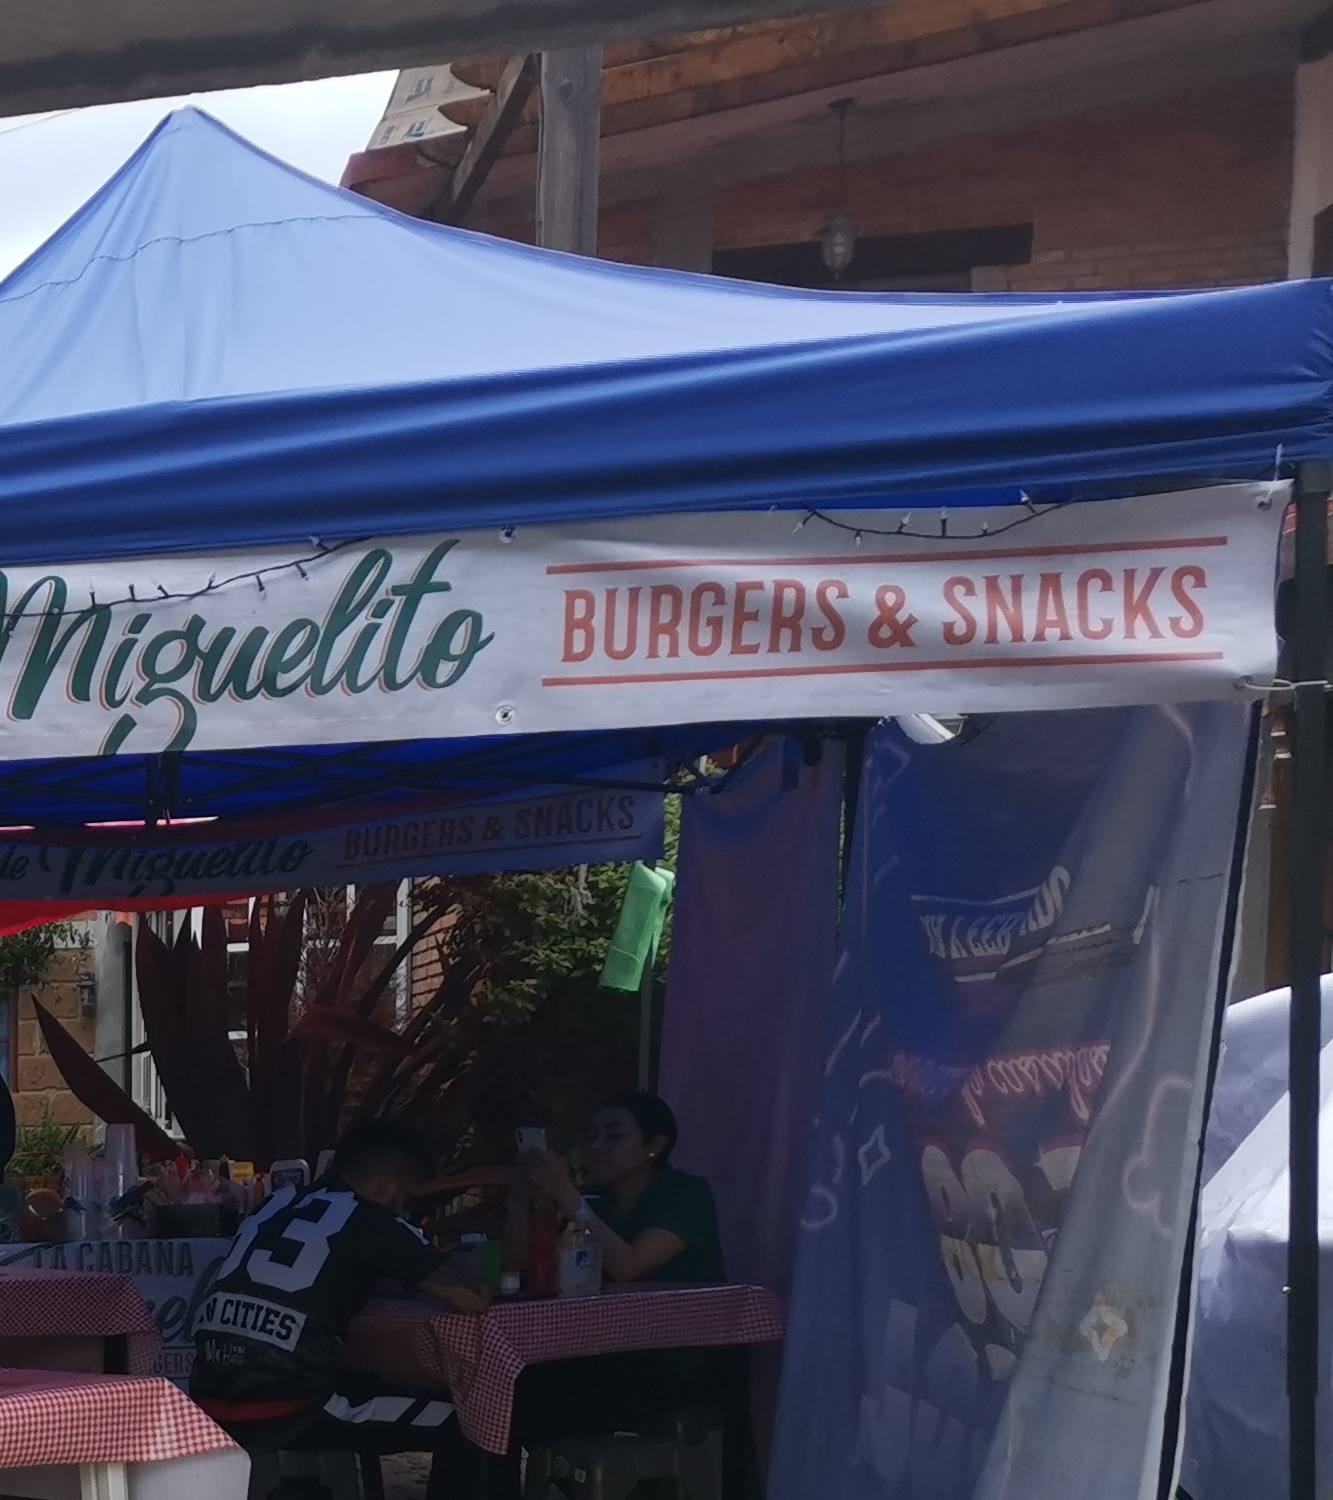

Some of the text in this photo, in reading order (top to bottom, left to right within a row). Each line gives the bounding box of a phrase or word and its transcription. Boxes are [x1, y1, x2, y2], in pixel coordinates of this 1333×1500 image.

[561, 578, 848, 664] BURGERS
[867, 584, 918, 650] &
[942, 564, 1208, 646] SNACKS
[344, 815, 475, 859] BURGERS
[482, 815, 503, 841] &
[516, 795, 635, 839] SNACKS
[220, 1299, 297, 1341] CITIES
